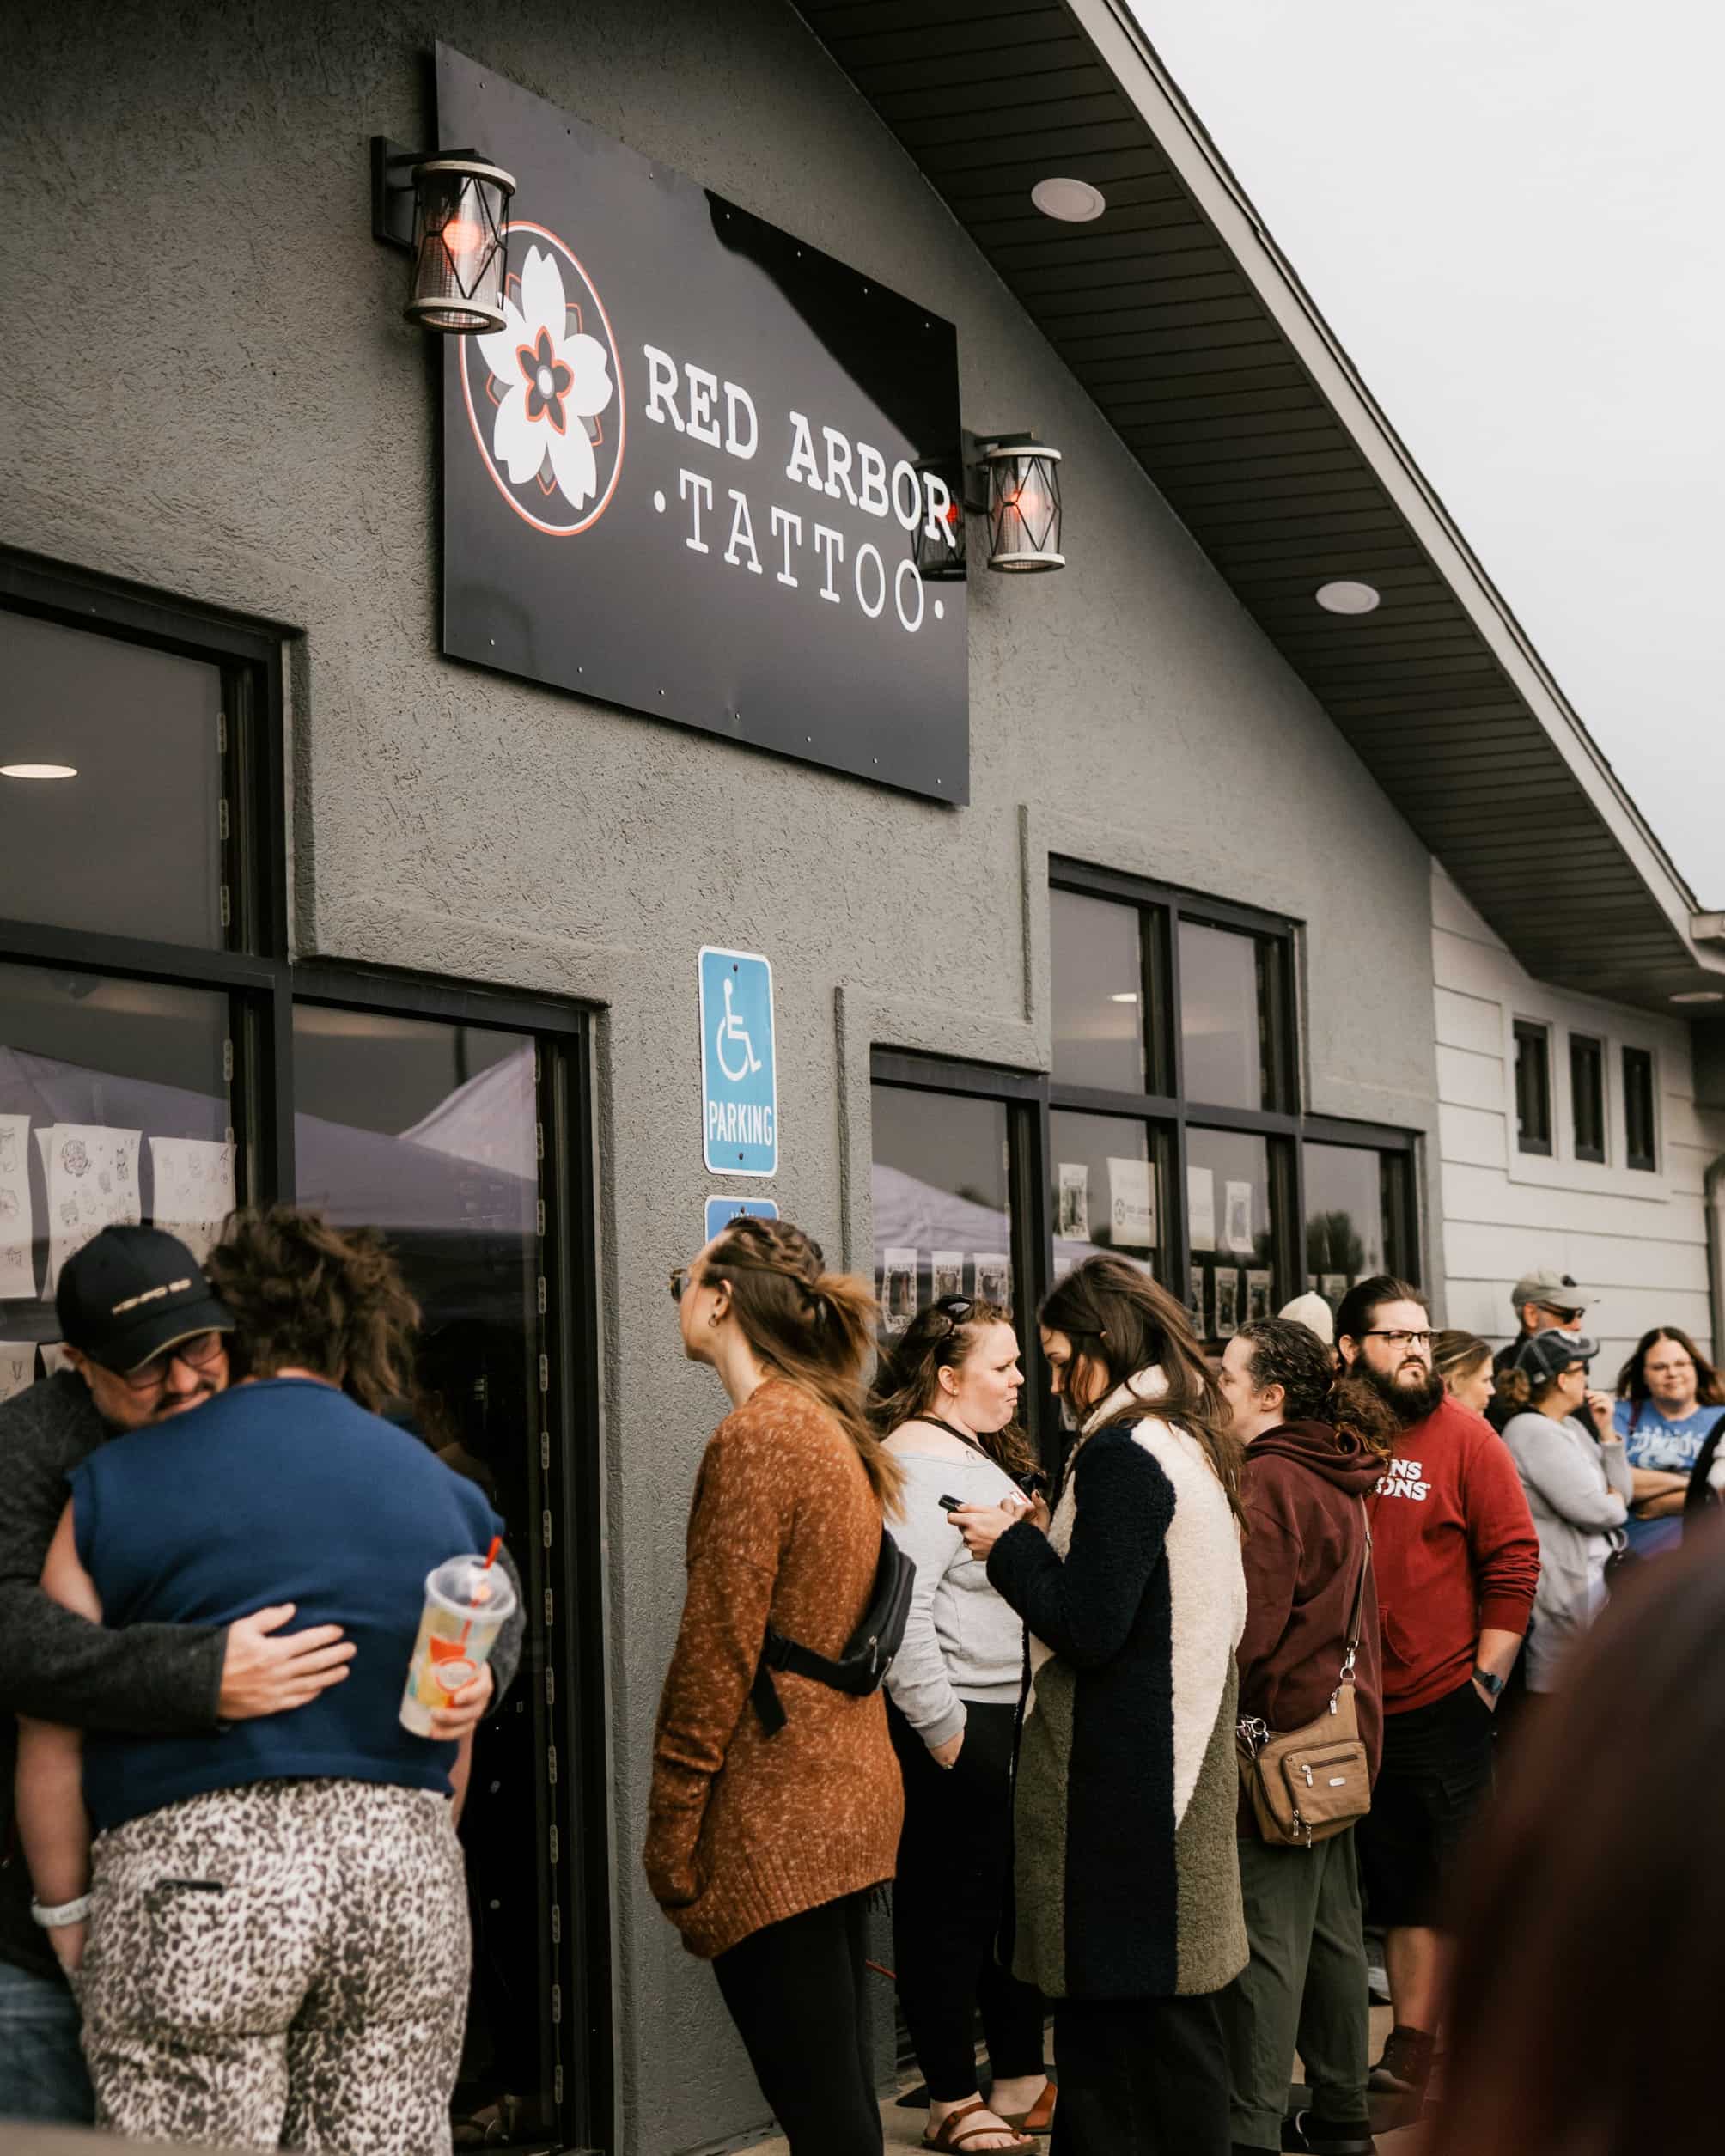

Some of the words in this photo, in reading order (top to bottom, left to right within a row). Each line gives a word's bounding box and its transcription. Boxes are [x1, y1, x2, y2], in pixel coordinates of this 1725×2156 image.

[644, 344, 758, 460] RED
[785, 411, 956, 548] ARBOR
[709, 1100, 773, 1146] PARKING
